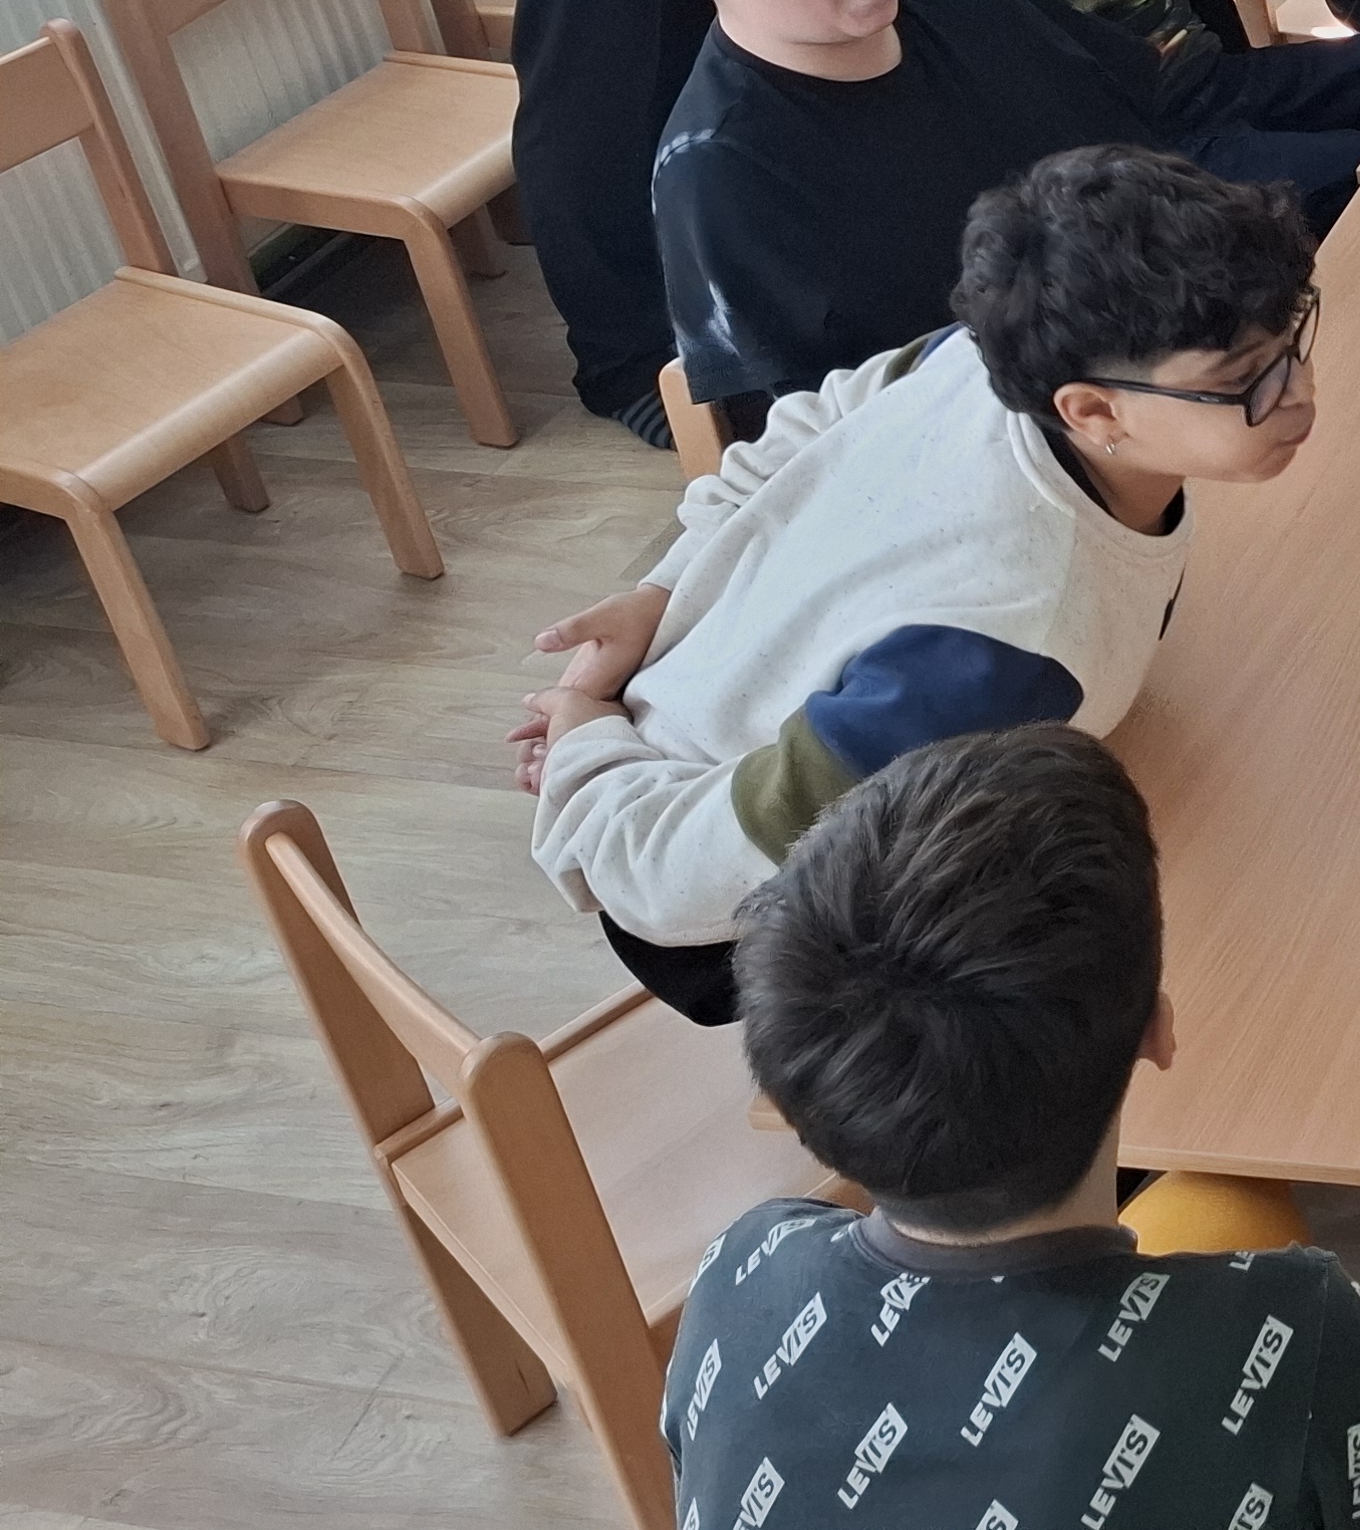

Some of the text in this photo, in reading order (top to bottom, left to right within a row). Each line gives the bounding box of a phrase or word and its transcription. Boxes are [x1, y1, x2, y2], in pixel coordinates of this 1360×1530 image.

[753, 1290, 828, 1400] LEVI'S
[1097, 1271, 1172, 1363] LEVI'S
[960, 1332, 1038, 1447] LEVI'S
[1221, 1313, 1295, 1436] LEVI'S
[732, 1456, 786, 1530] VI'S
[837, 1401, 909, 1510] LEVI'S
[1080, 1412, 1161, 1530] LEVI'S
